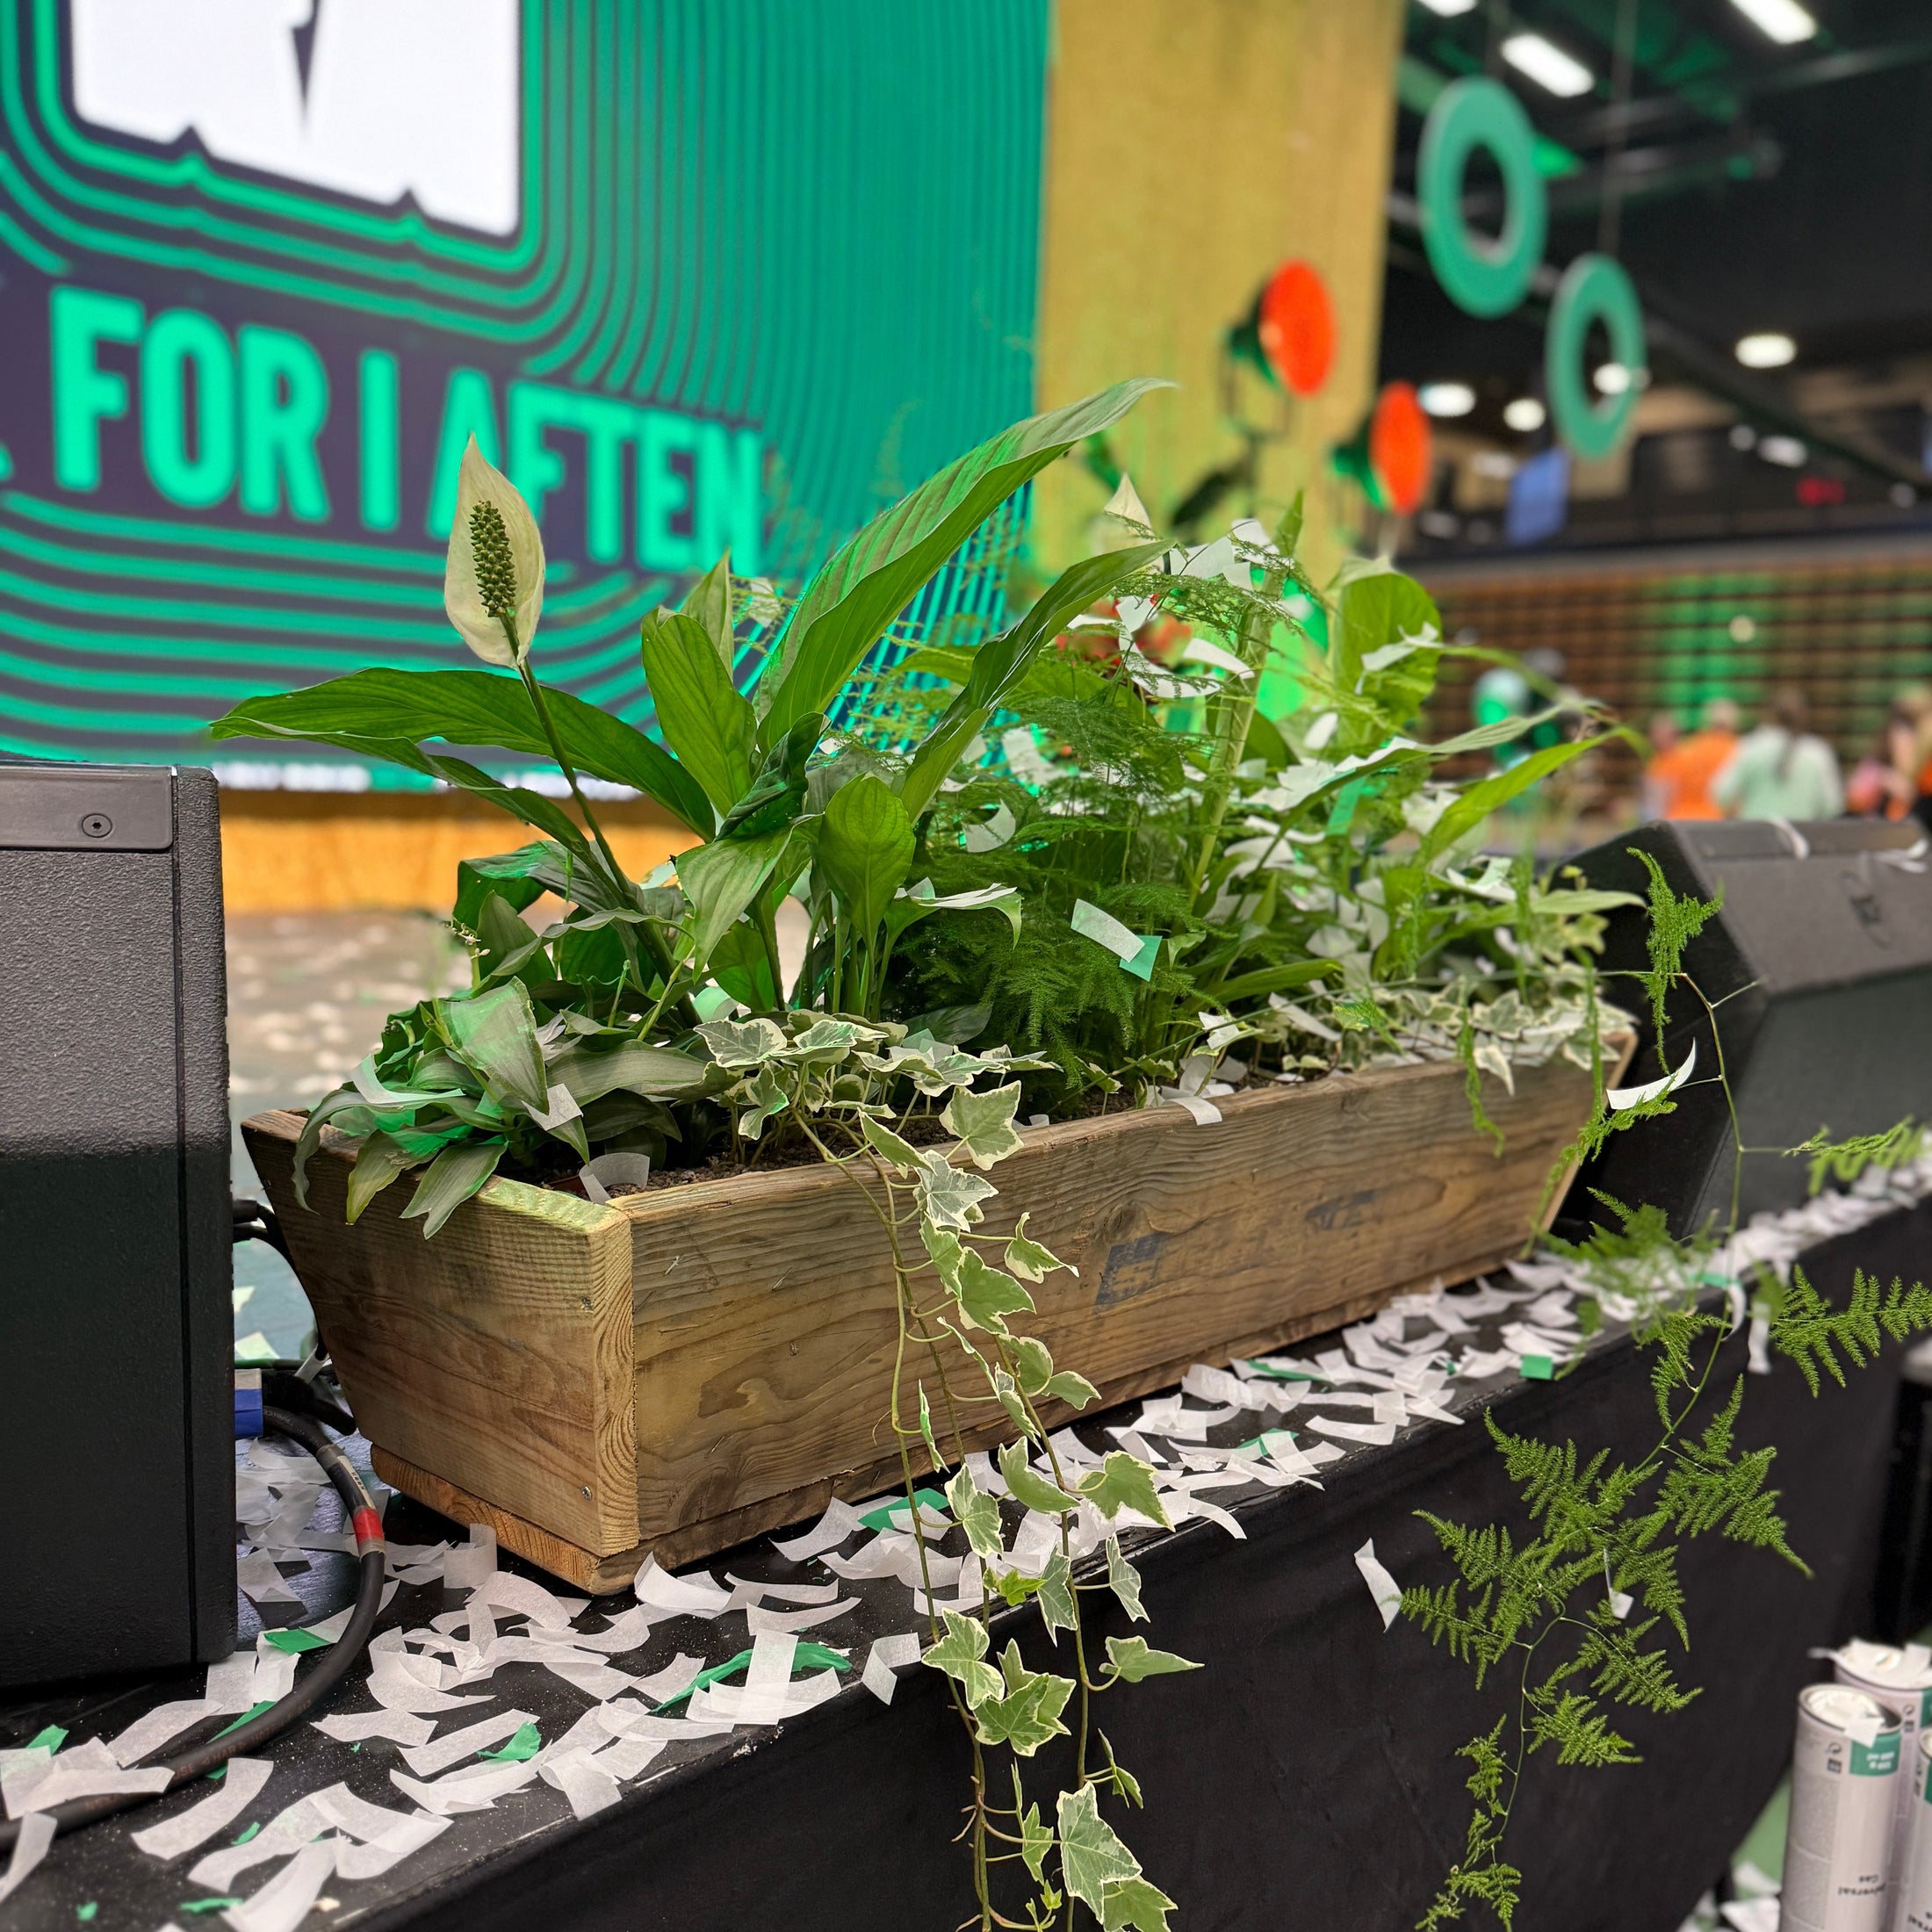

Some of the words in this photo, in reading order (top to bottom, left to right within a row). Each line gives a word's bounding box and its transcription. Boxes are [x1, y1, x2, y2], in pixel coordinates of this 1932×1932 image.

[51, 284, 329, 523] FOR
[361, 350, 399, 530] I
[428, 370, 761, 577] AFTEN
